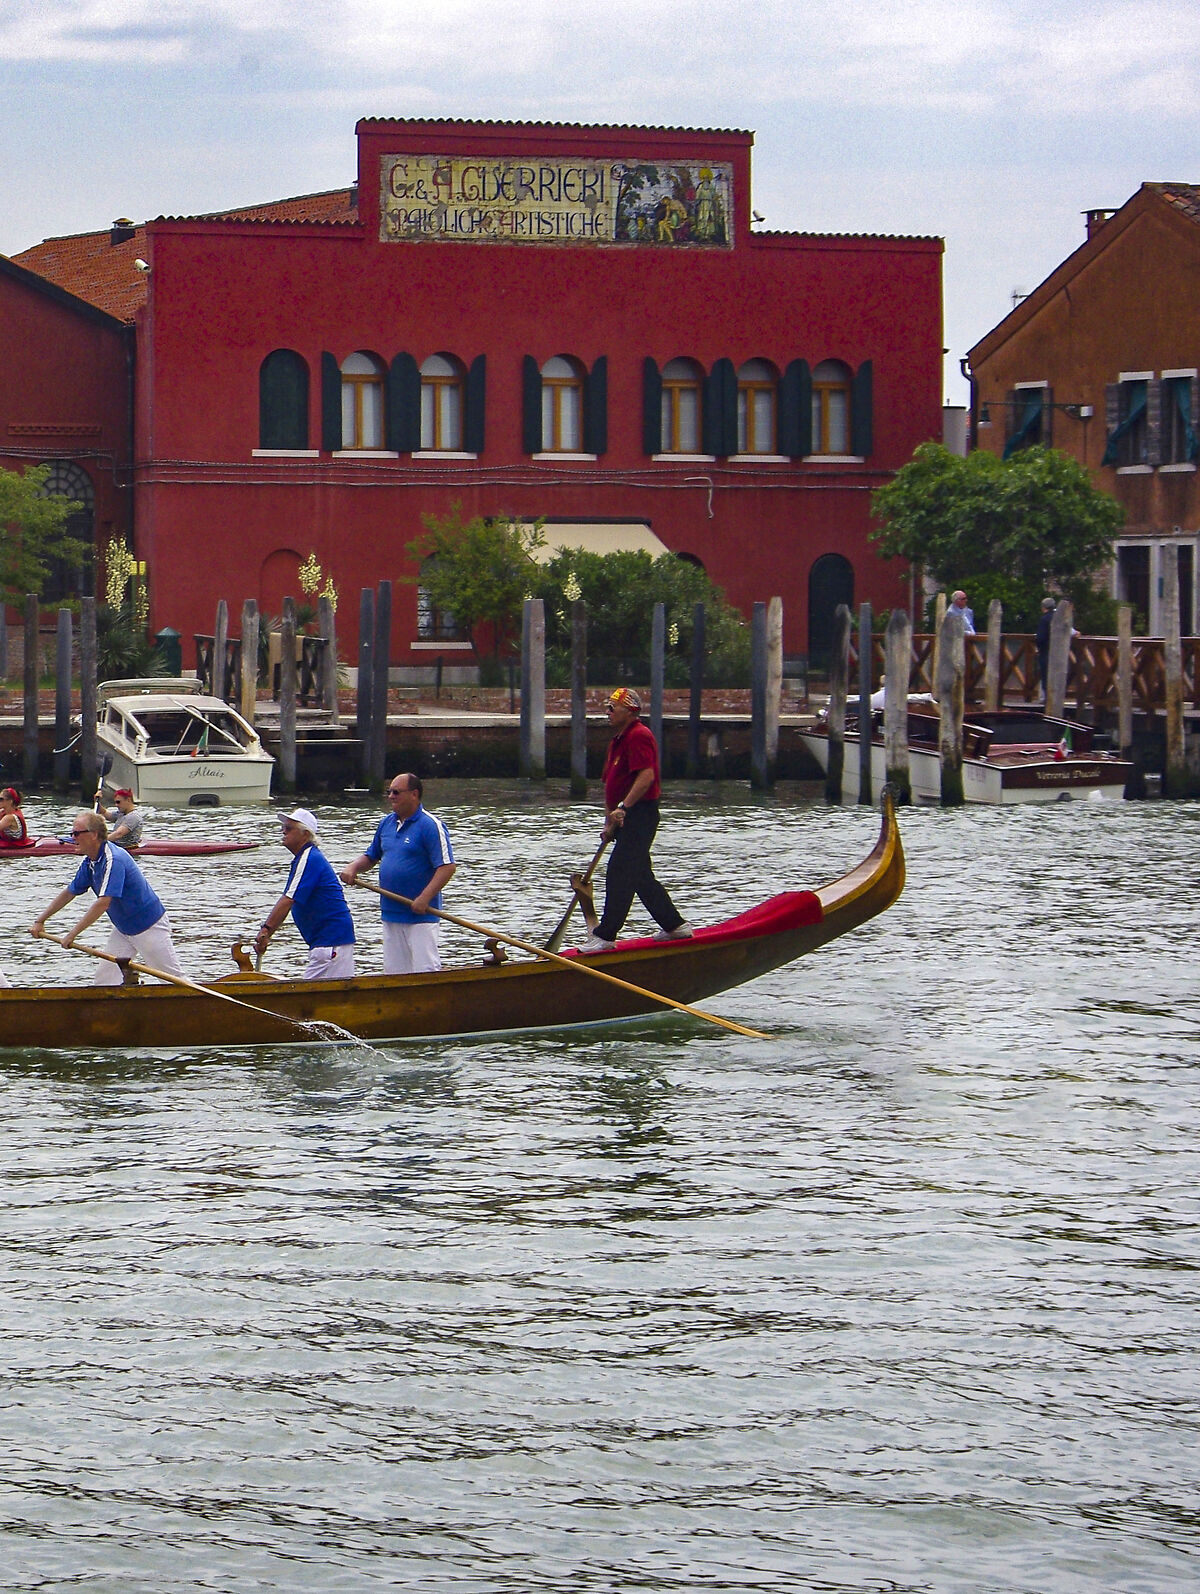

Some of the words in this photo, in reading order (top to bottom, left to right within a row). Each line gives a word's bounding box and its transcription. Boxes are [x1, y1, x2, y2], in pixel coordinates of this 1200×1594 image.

[415, 179, 427, 200] &
[500, 210, 609, 236] ARTISTICHE
[188, 766, 225, 778] Altair
